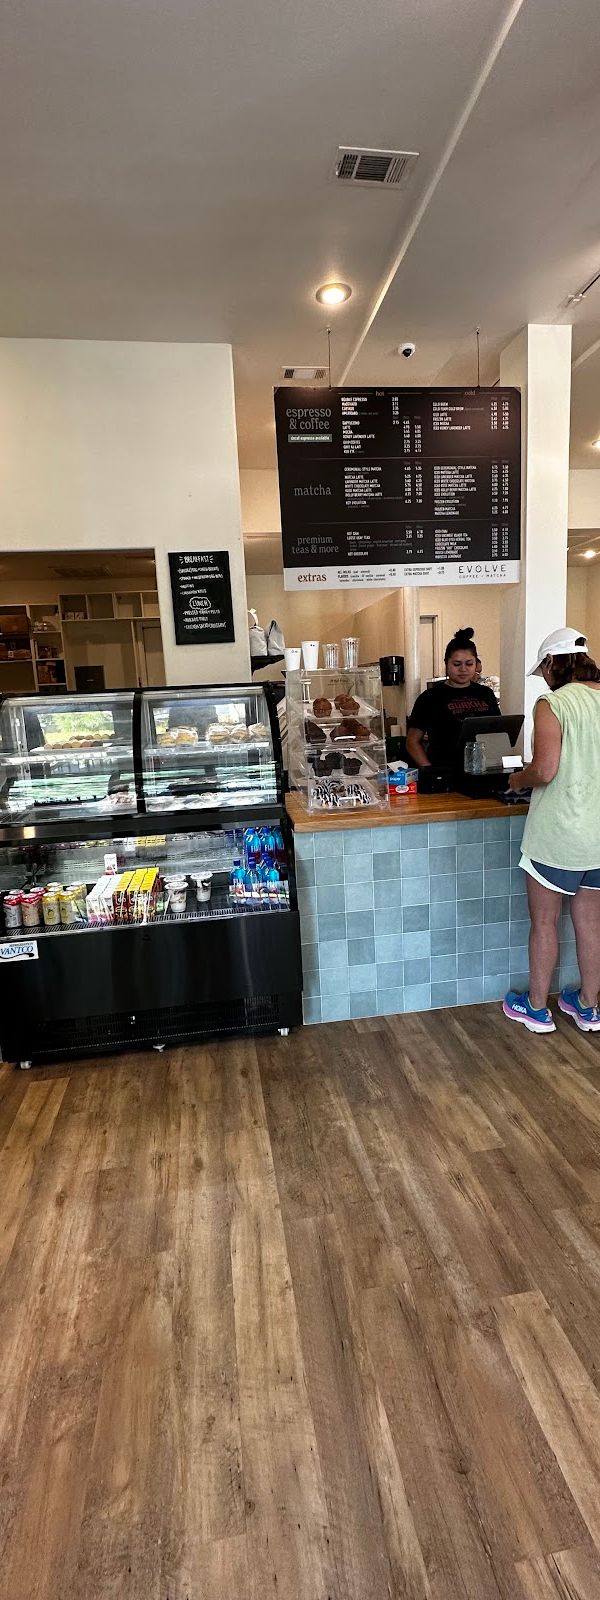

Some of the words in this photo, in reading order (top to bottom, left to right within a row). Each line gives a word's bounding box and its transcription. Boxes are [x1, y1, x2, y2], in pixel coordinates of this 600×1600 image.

[286, 408, 332, 419] espresso
[289, 419, 298, 430] &
[299, 418, 330, 430] coffee
[293, 484, 332, 496] matcha
[297, 535, 333, 545] premium
[291, 545, 309, 554] teas
[310, 544, 317, 554] &
[318, 545, 340, 554] more
[458, 564, 507, 574] EVOLVE
[297, 572, 327, 583] extras
[447, 701, 489, 710] GURKHA
[511, 1003, 528, 1014] HOKA
